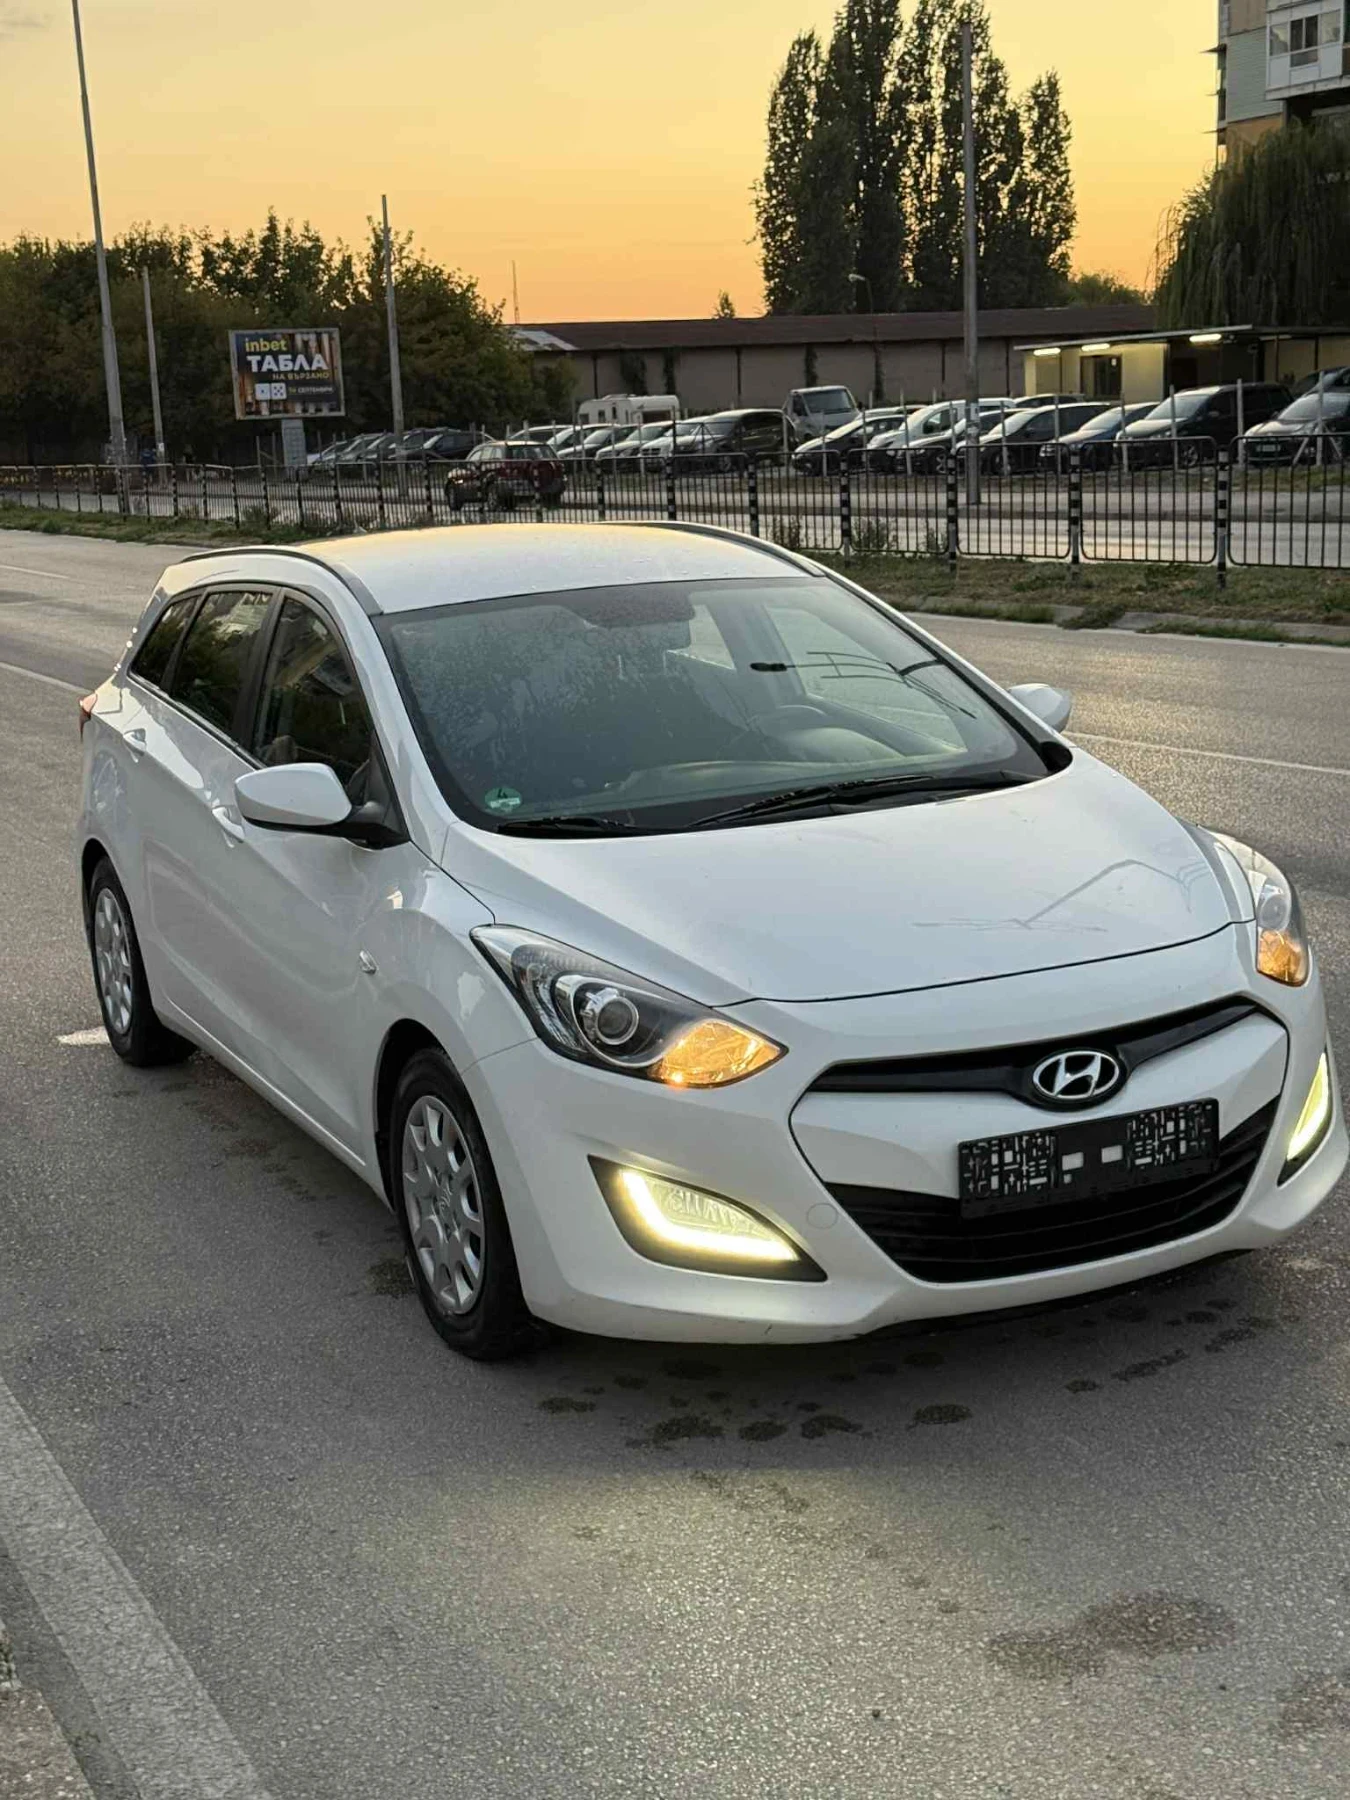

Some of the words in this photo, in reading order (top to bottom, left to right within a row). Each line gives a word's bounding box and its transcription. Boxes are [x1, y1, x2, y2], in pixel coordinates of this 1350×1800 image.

[245, 338, 287, 352] inbet
[246, 353, 329, 372] ТАБЛА
[287, 372, 329, 380] ВЪРЗАНО
